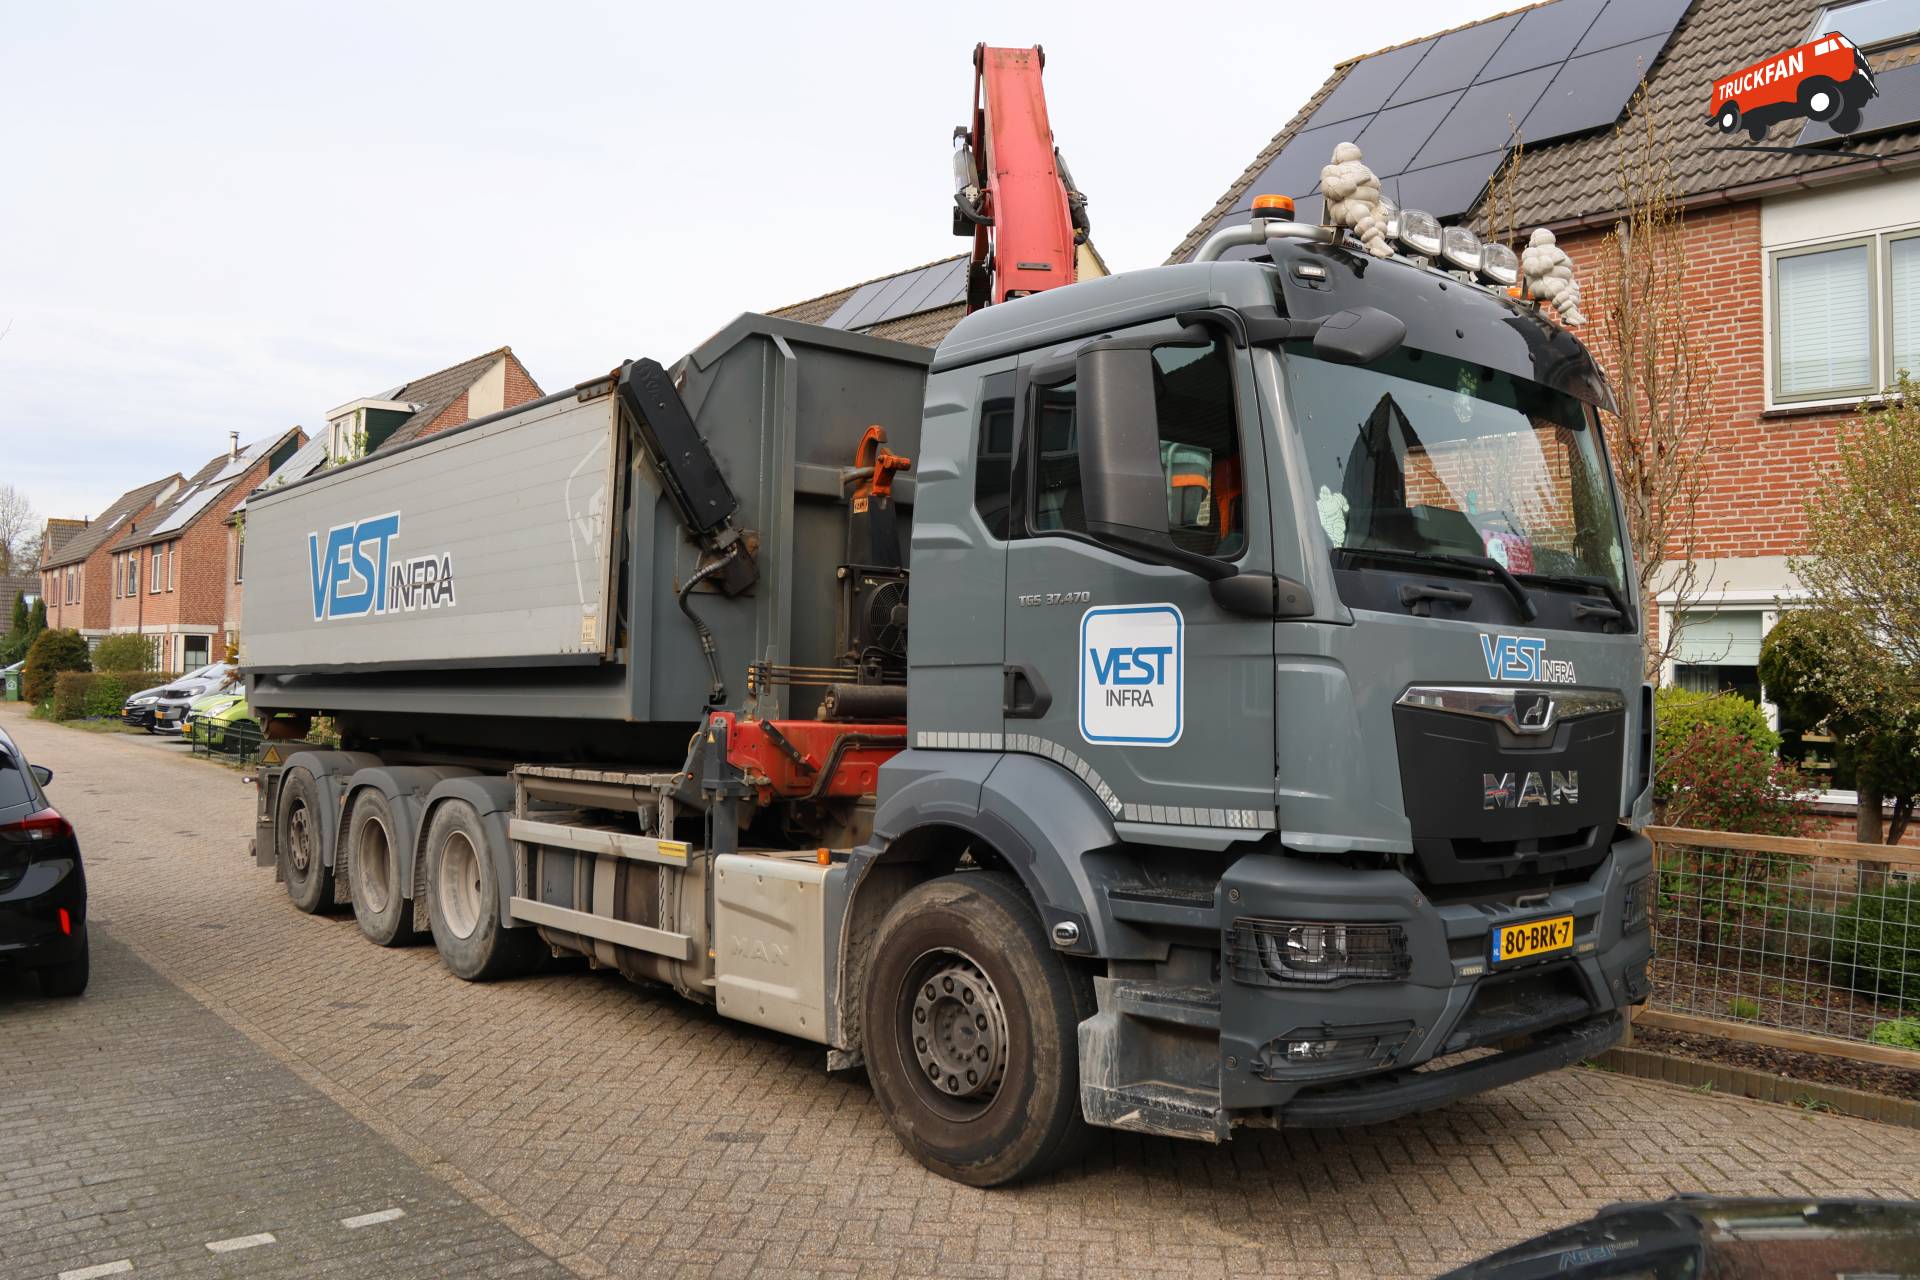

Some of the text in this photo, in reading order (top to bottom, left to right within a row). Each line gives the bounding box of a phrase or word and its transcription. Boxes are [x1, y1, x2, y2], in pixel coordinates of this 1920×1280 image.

[308, 511, 456, 622] VEST INFRA
[1018, 591, 1090, 607] TGS 37.470
[1089, 646, 1173, 685] VEST
[1480, 634, 1576, 683] VEST INFRA
[1106, 689, 1154, 707] INFRA
[1483, 770, 1578, 810] MAN
[730, 935, 790, 967] MAN
[1505, 921, 1570, 955] 80-BRK-7
